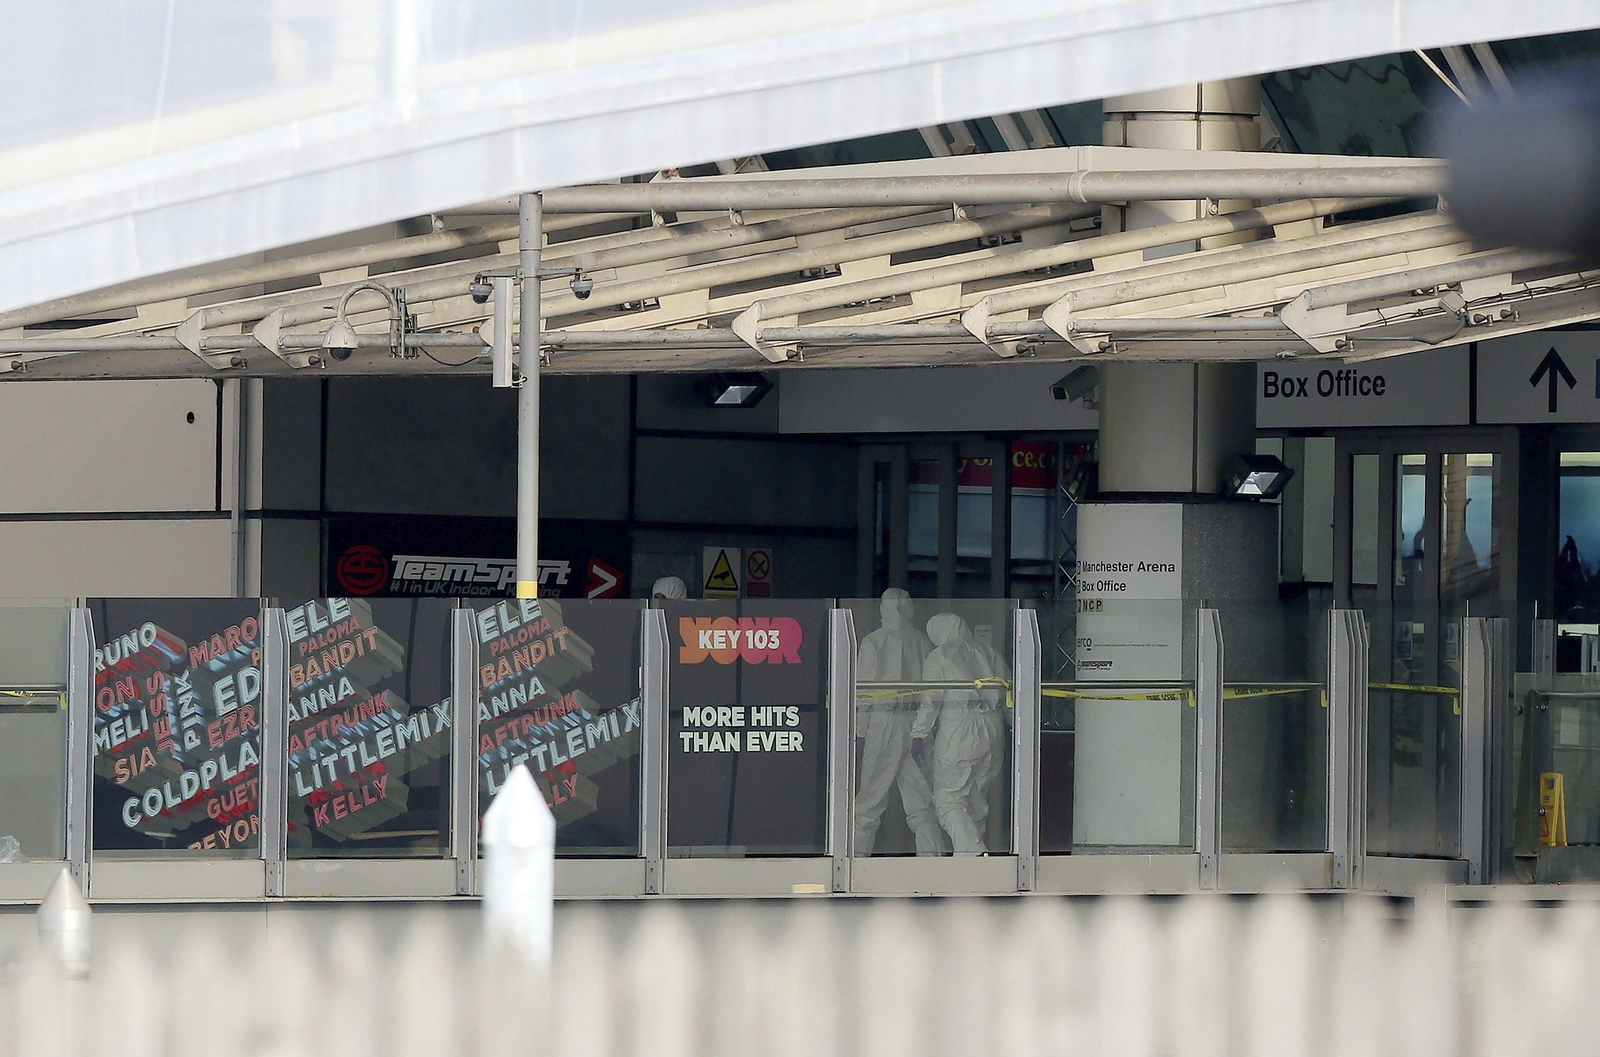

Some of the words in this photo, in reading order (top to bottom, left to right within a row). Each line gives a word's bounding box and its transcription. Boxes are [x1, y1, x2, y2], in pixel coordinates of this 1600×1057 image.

[1264, 371, 1309, 398] Box
[1316, 369, 1386, 398] Office
[391, 555, 572, 590] TeamSprt
[1082, 561, 1133, 572] Manchester
[1137, 561, 1175, 572] Arena
[1082, 581, 1094, 592] Box
[1096, 580, 1127, 592] Office
[424, 581, 449, 594] UK
[449, 582, 496, 595] Indoor
[505, 584, 561, 598] King
[188, 614, 261, 669] MARO
[286, 597, 351, 643] ELE
[298, 617, 361, 656] PALOMA
[477, 598, 542, 643] ELE
[490, 618, 551, 656] PALOMA
[698, 629, 742, 649] KEY
[745, 629, 780, 649] 103
[290, 626, 378, 688] BANDIT
[480, 626, 568, 688] BANDIT
[97, 675, 136, 712] ON
[146, 670, 175, 754] JESS
[214, 666, 261, 718] ED
[288, 676, 356, 722] ANNA
[478, 676, 546, 722] ANNA
[94, 705, 149, 756] MELI
[206, 704, 258, 749] EZR
[290, 689, 391, 755] AFTPUNK
[480, 689, 581, 755] AFTPUNK
[683, 706, 745, 727] MORE
[751, 706, 800, 727] HITS
[294, 697, 450, 797] LITTLEMIX
[679, 731, 740, 752] THAN
[746, 731, 803, 752] EVER
[114, 746, 158, 784] SIA
[122, 735, 260, 828] COLDPLA
[206, 777, 259, 819] GUET
[314, 773, 388, 828] KELLY
